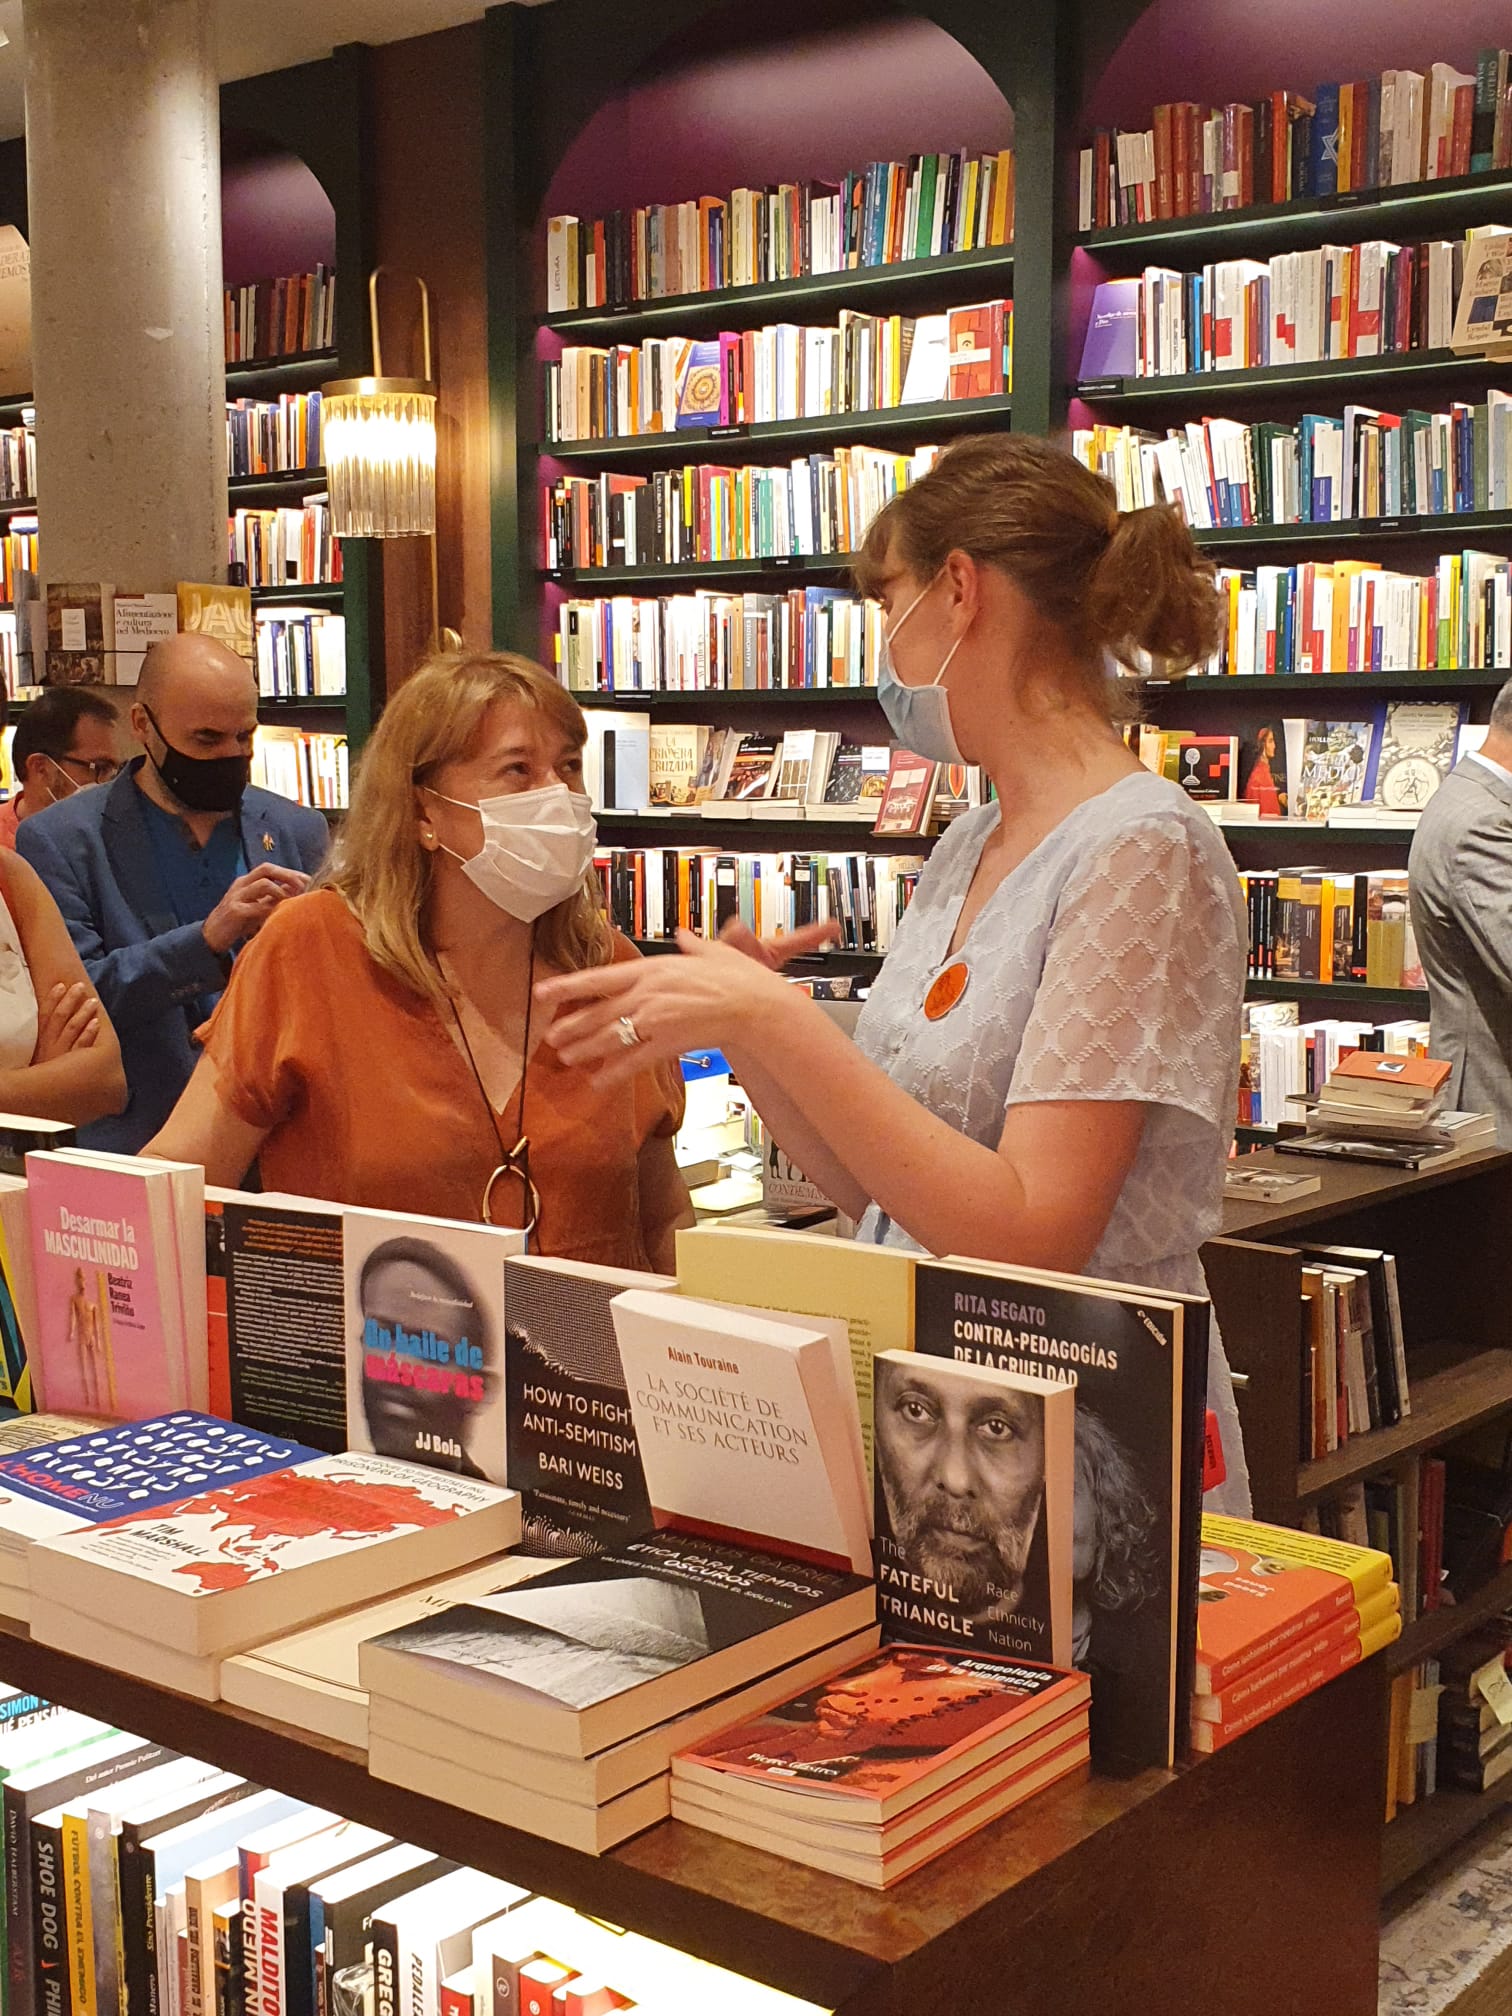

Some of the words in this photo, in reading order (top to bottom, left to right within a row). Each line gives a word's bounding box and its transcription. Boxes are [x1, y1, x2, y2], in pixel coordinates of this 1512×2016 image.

[60, 1206, 120, 1239] Desarmar
[122, 1218, 135, 1243] la
[43, 1229, 138, 1270] MASCULINIDAD
[955, 1292, 987, 1316] RITA
[991, 1301, 1046, 1327] SEGATO
[365, 1318, 392, 1349] Un
[395, 1324, 449, 1364] baile
[454, 1336, 483, 1370] de
[668, 1346, 693, 1365] Alain
[694, 1351, 739, 1374] Touraine
[954, 1319, 1118, 1370] CONTRA-PEDAGOGÍAS
[365, 1352, 485, 1402] máscaras
[523, 1383, 563, 1409] HOW
[566, 1393, 587, 1414] TO
[647, 1372, 669, 1395] LA
[674, 1381, 752, 1412] SOCIÉTÉ
[757, 1397, 783, 1420] DE
[523, 1412, 636, 1457] ANTI-SEMITISM
[636, 1390, 808, 1446] COMMUNICATION
[415, 1432, 431, 1451] JJ
[433, 1435, 462, 1458] Bola
[652, 1415, 671, 1436] ET
[677, 1423, 707, 1444] SES
[713, 1432, 800, 1464] ACTEURS
[393, 1472, 412, 1481] OF
[412, 1478, 490, 1502] GEOGRAPHY
[539, 1452, 572, 1476] BARI
[576, 1462, 624, 1490] WEISS
[131, 1529, 209, 1557] MARSHALL
[150, 1523, 184, 1537] TIM
[880, 1536, 906, 1560] The
[663, 1558, 754, 1588] OSCUROS
[682, 1555, 733, 1573] PARA
[741, 1568, 824, 1599] TIEMPOS
[880, 1564, 960, 1604] FATEFUL
[986, 1582, 1018, 1601] Race
[880, 1594, 974, 1637] TRIANGLE
[987, 1605, 1046, 1635] Ethnicity
[988, 1629, 1032, 1652] Nation
[948, 1667, 967, 1675] la
[967, 1670, 1041, 1689] violencia
[958, 1659, 1053, 1681] Arqueología
[0, 1695, 39, 1719] SIMON
[10, 1810, 18, 1844] DAVID
[38, 1840, 56, 1896] SHOE
[41, 1902, 59, 1950] DOG
[261, 1907, 281, 2016] MALDITO
